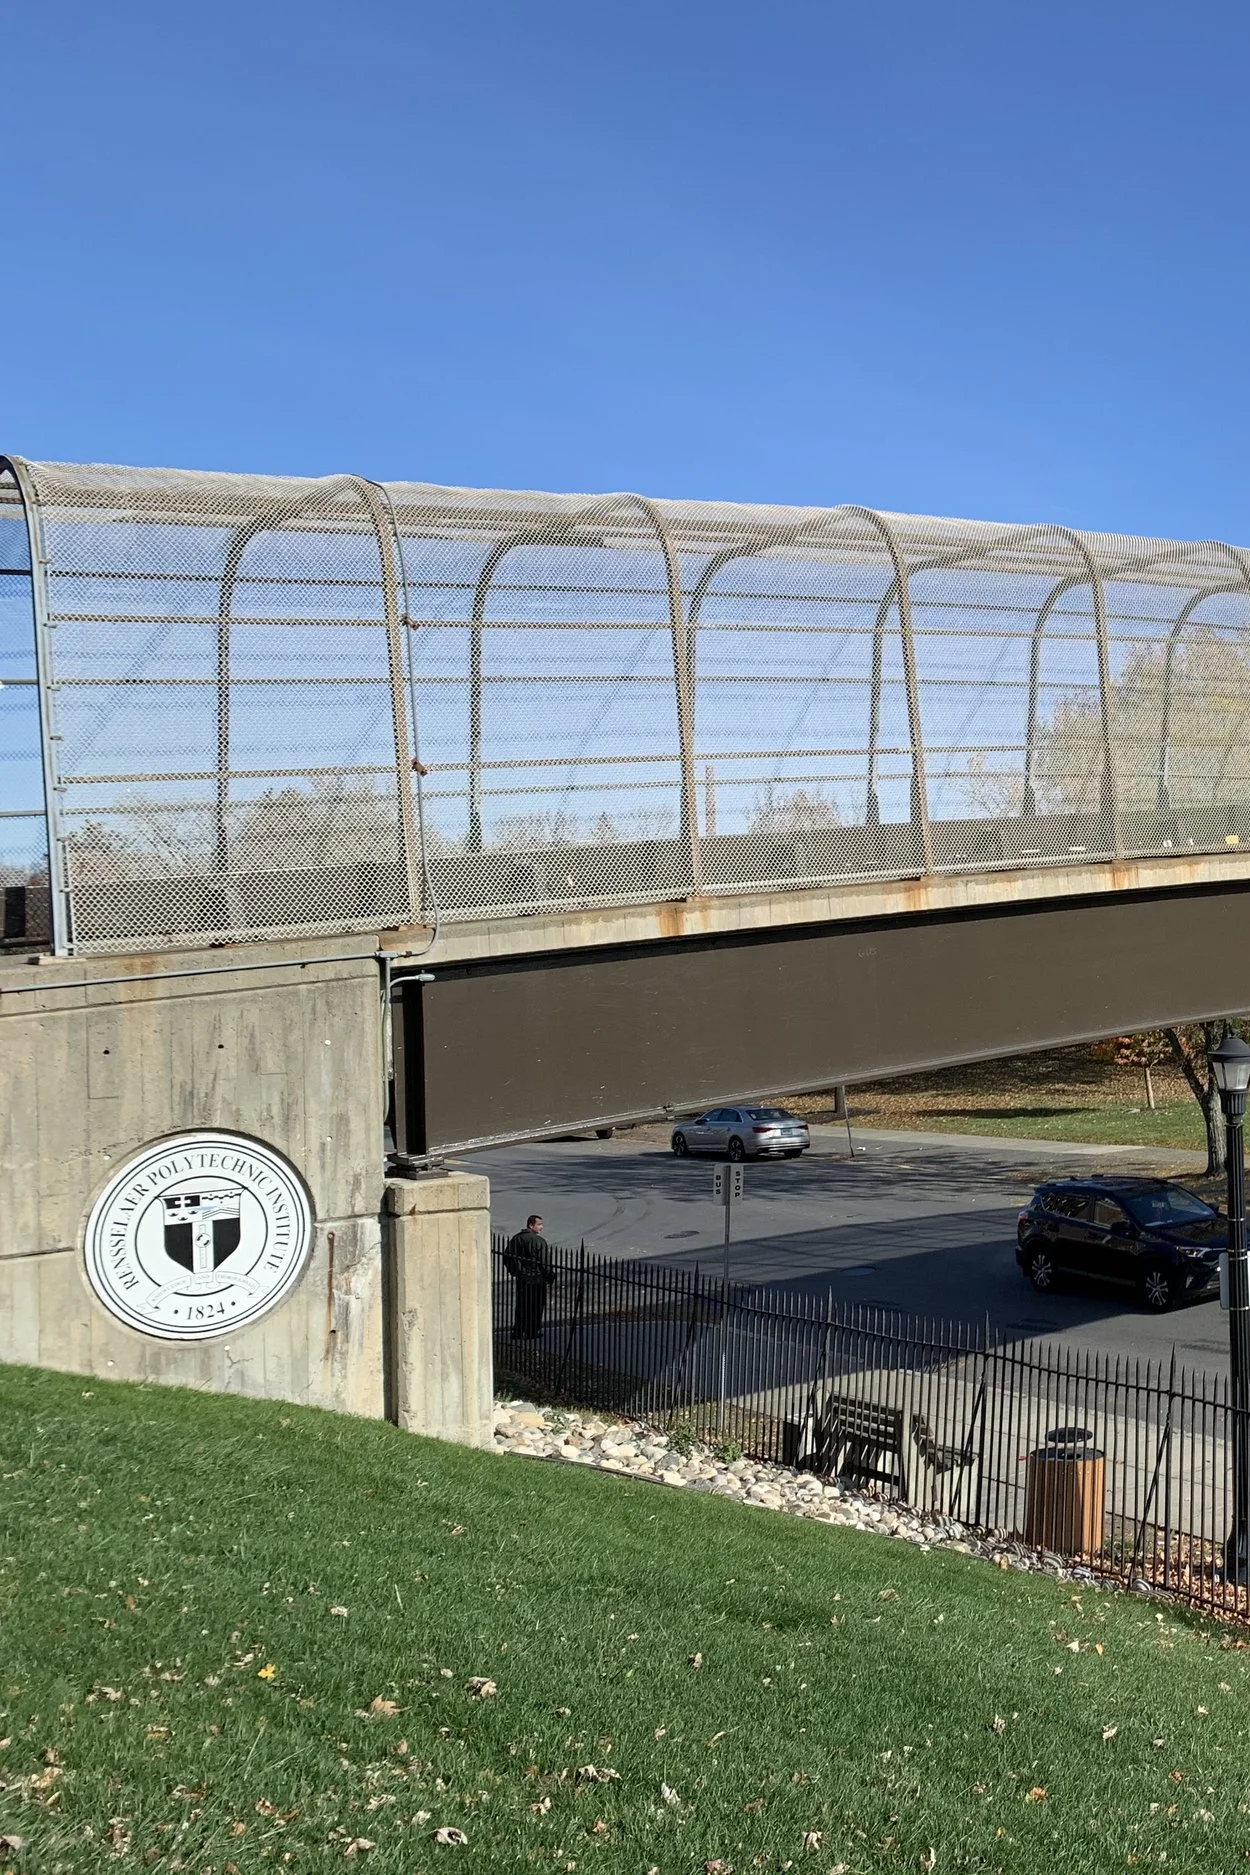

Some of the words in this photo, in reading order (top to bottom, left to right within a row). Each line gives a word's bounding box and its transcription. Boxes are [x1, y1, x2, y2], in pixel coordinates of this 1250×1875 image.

[110, 1183, 150, 1290] RENSSELAER
[147, 1153, 273, 1189] POLYTECHNIC
[264, 1185, 291, 1273] INSTITUTE
[187, 1302, 225, 1320] 1824
